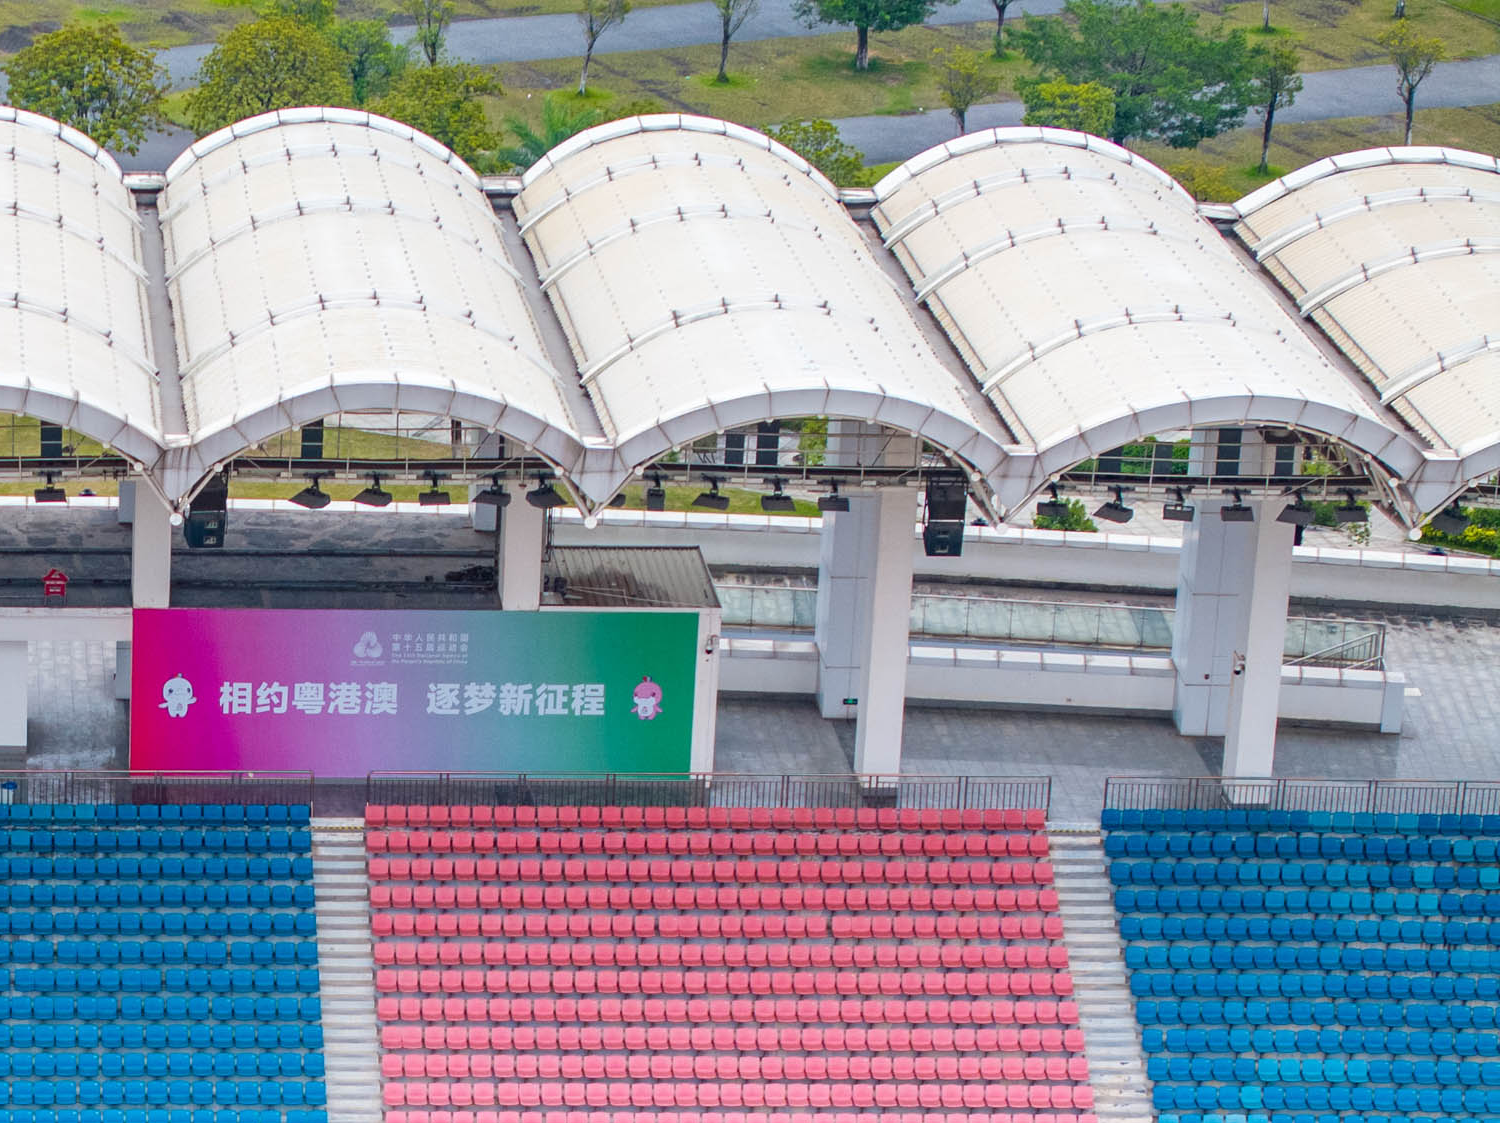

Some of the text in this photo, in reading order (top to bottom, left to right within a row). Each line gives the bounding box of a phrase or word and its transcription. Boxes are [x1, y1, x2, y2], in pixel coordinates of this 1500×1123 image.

[218, 681, 606, 717] 相约粤港澳 逐梦新征程
